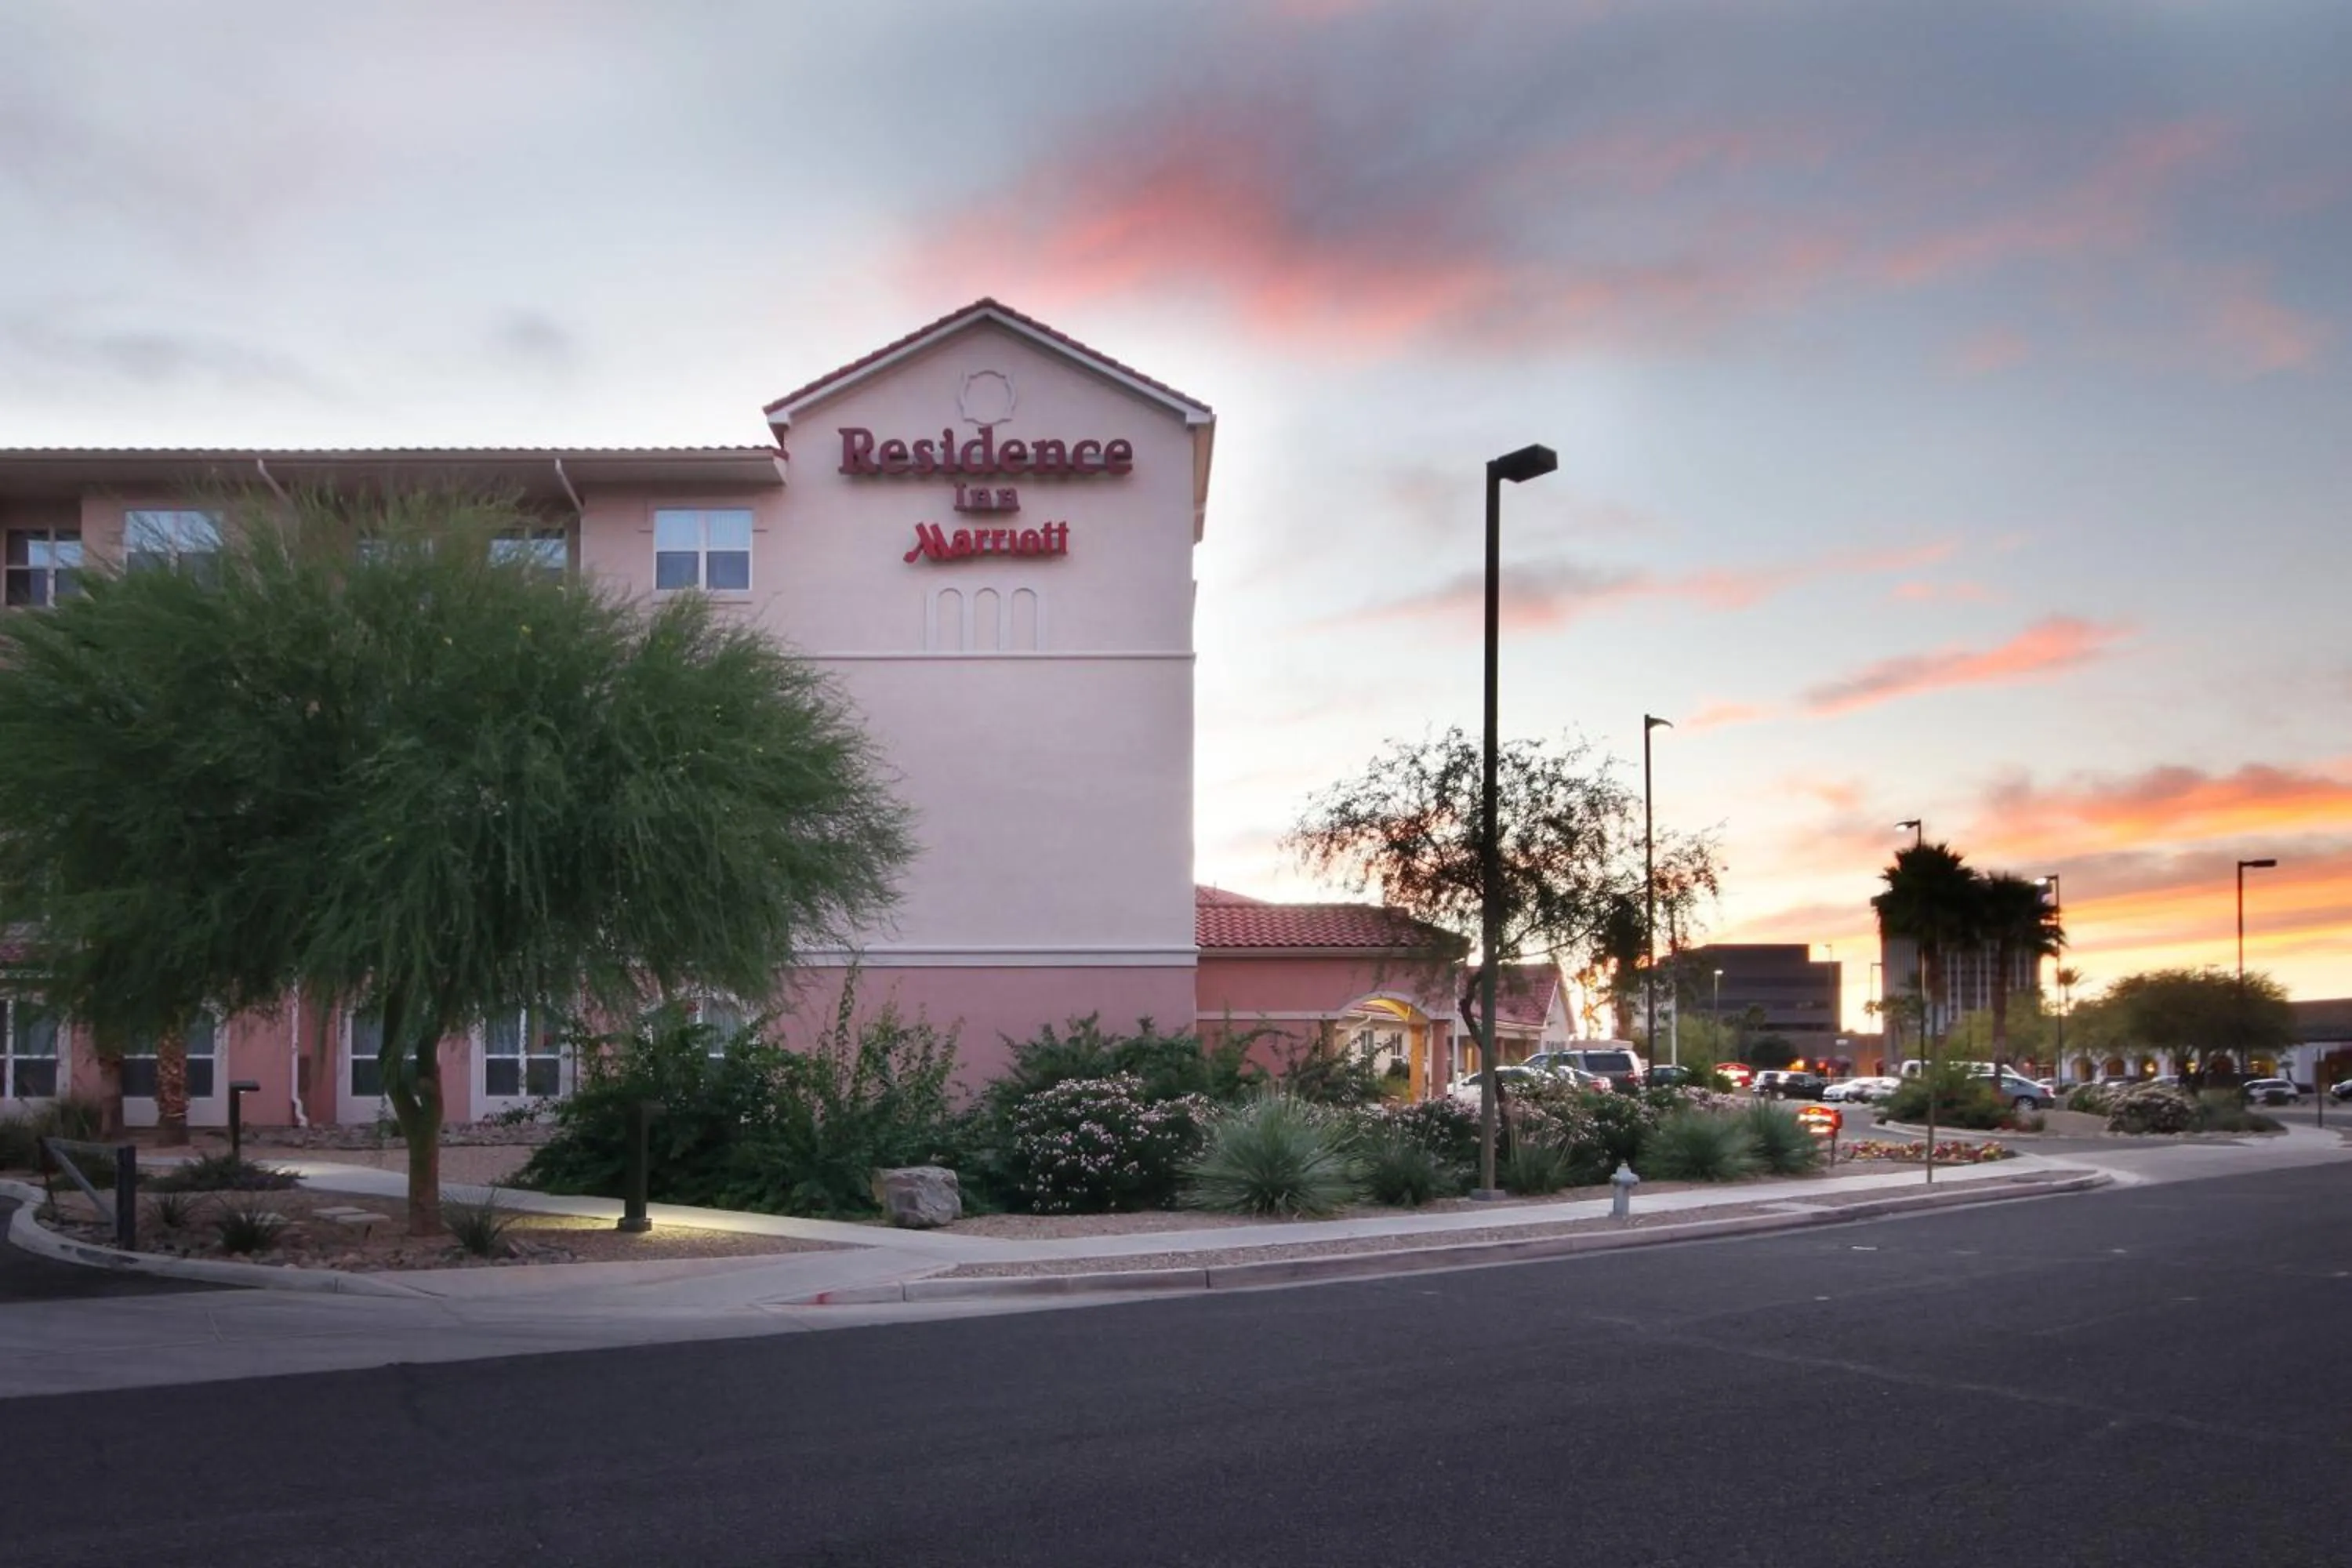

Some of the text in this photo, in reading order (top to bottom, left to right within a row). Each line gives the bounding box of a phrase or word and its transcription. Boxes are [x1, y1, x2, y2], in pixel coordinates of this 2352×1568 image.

[838, 427, 1133, 474] Residence
[953, 482, 1020, 511] Inn
[903, 521, 1069, 563] Marriott
